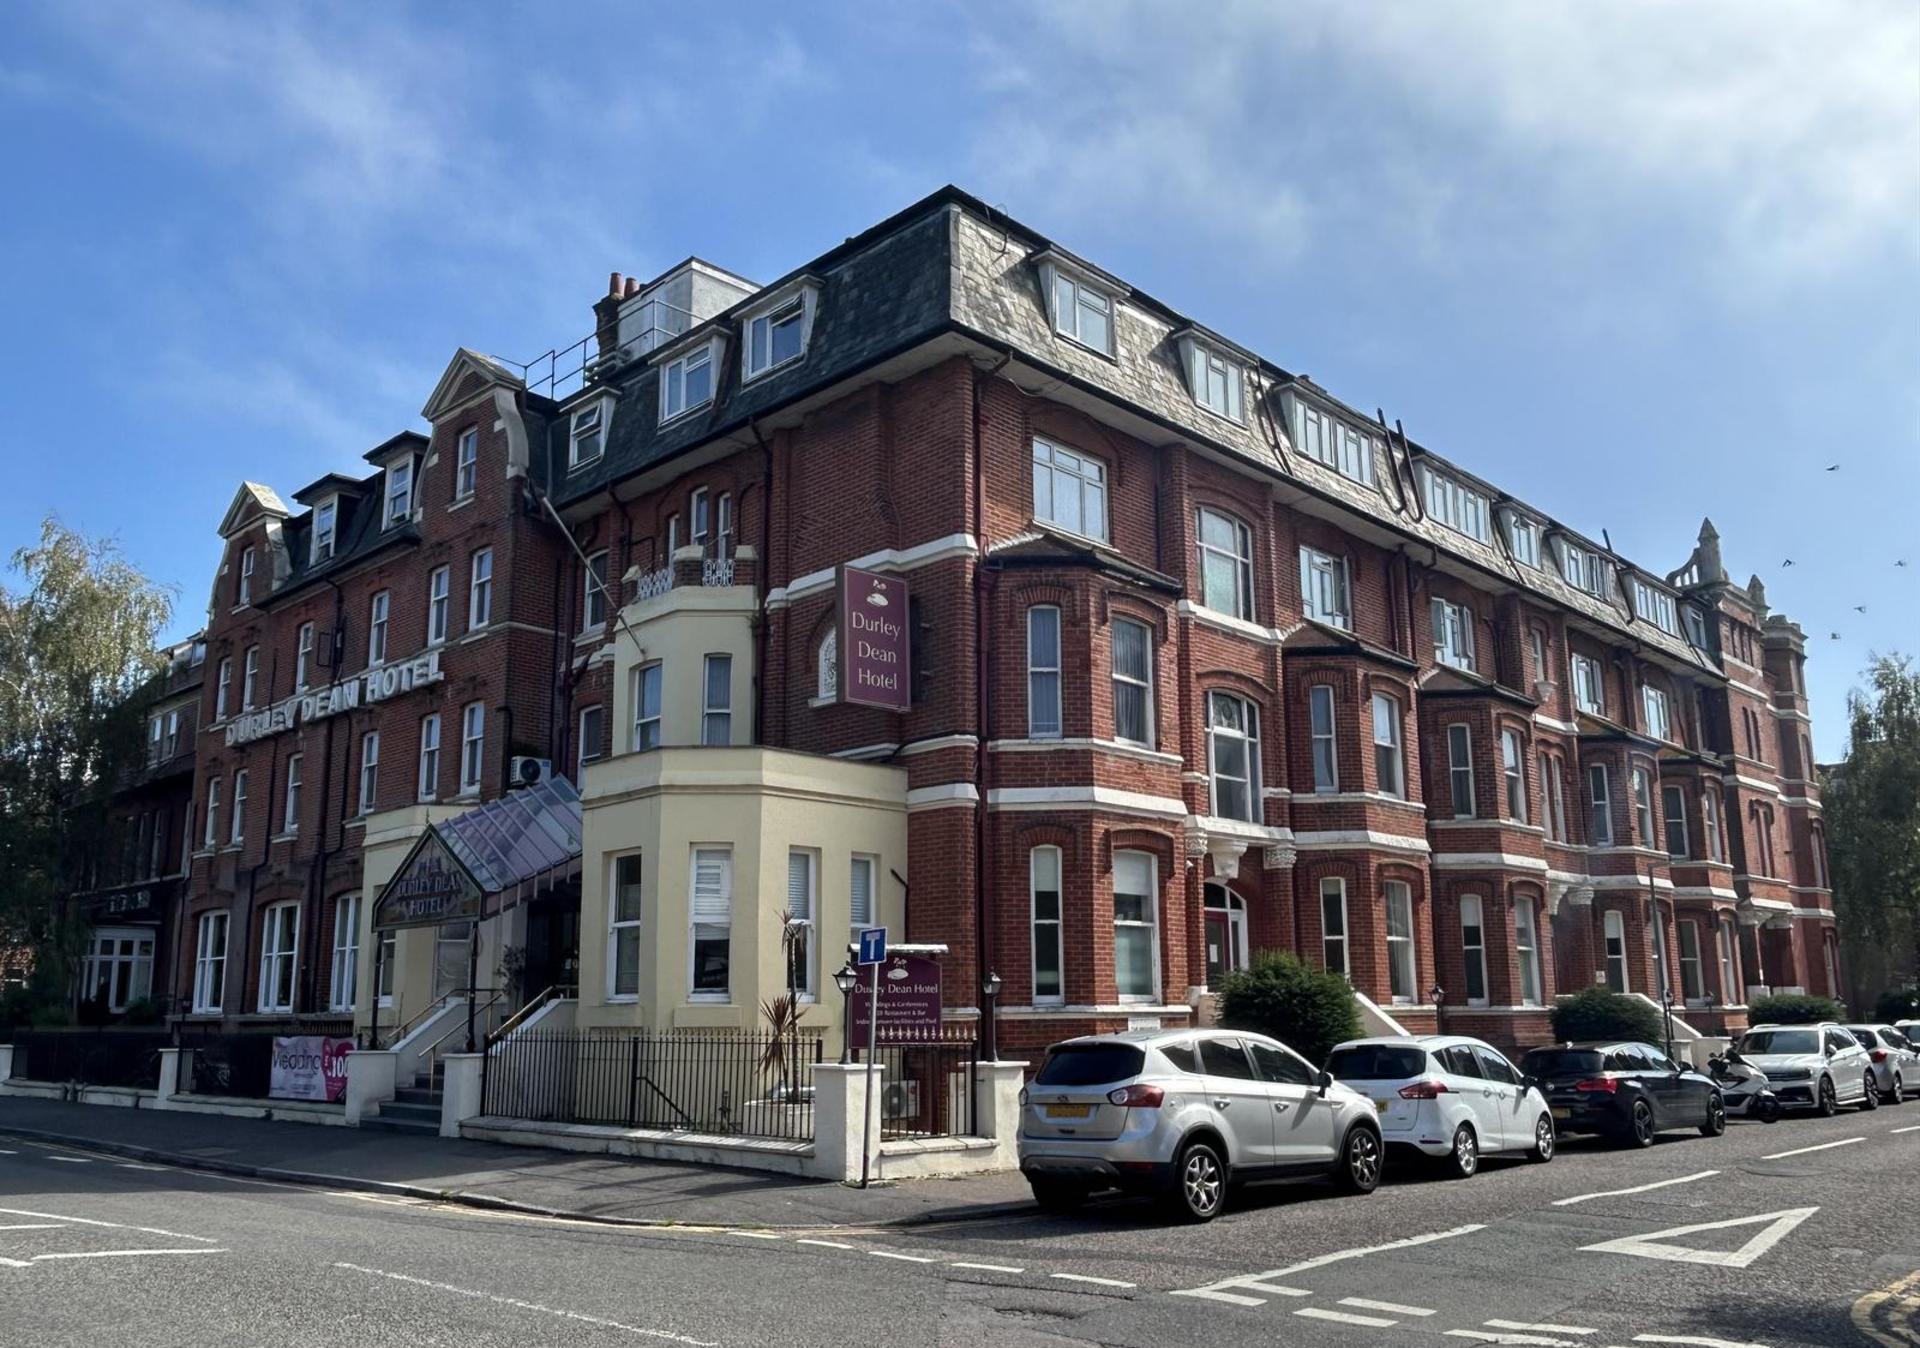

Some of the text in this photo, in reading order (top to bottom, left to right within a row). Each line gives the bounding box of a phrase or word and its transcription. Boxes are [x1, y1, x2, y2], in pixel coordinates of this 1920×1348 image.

[852, 611, 900, 640] Durley
[858, 641, 896, 663] Dean
[858, 668, 897, 690] Hotel
[225, 651, 444, 746] DURLEY DEAN HOTEL
[888, 984, 912, 993] Dean
[914, 984, 938, 993] Hotel
